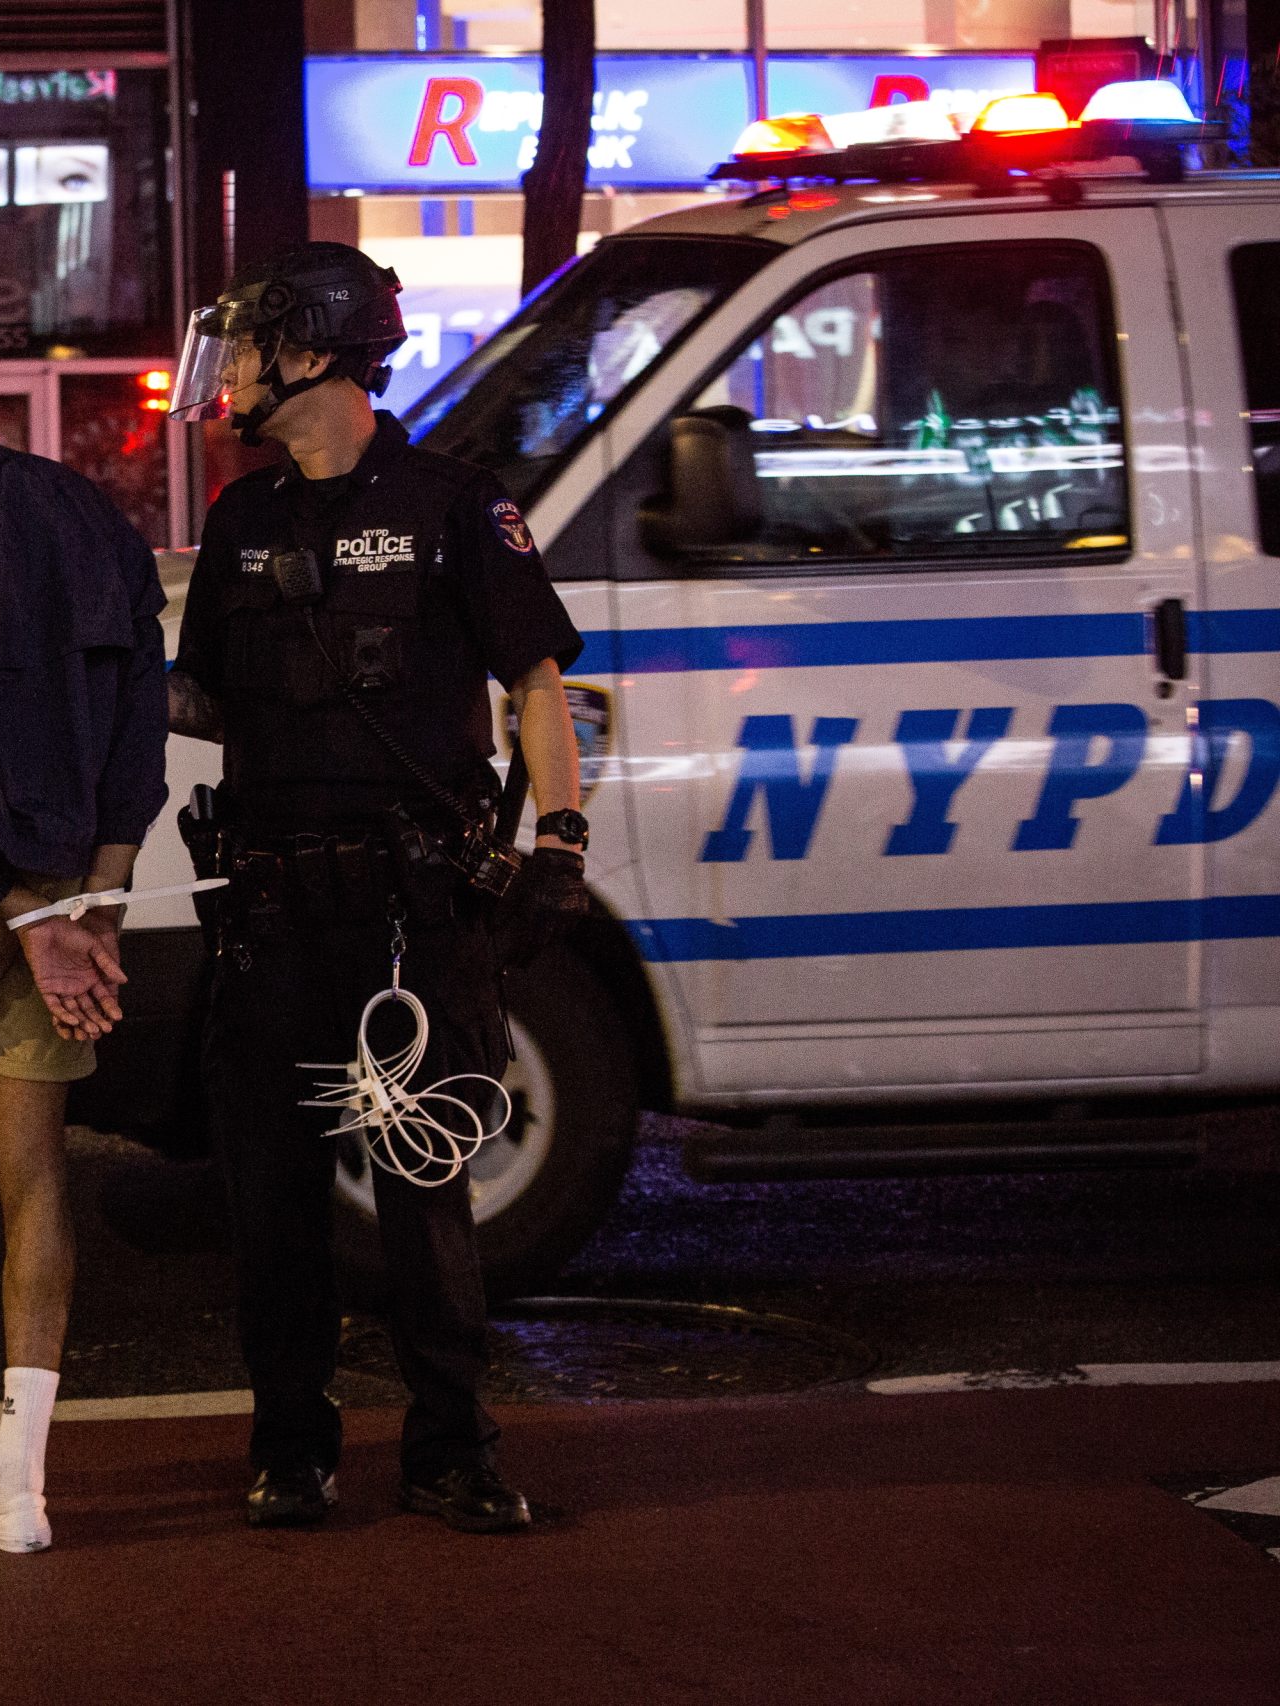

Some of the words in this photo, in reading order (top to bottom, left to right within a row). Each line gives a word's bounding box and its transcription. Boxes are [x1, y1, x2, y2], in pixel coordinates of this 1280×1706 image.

[407, 77, 649, 168] REPLIC
[517, 135, 637, 169] BNK
[328, 290, 350, 302] 742
[492, 502, 520, 517] POLIC
[362, 529, 389, 538] NYPD
[336, 535, 414, 557] POLICE
[241, 549, 270, 560] HONG
[333, 556, 374, 567] STRATEGIC
[375, 553, 415, 563] RESPONSE
[357, 563, 388, 572] GROUP
[699, 698, 1280, 862] NYPD
